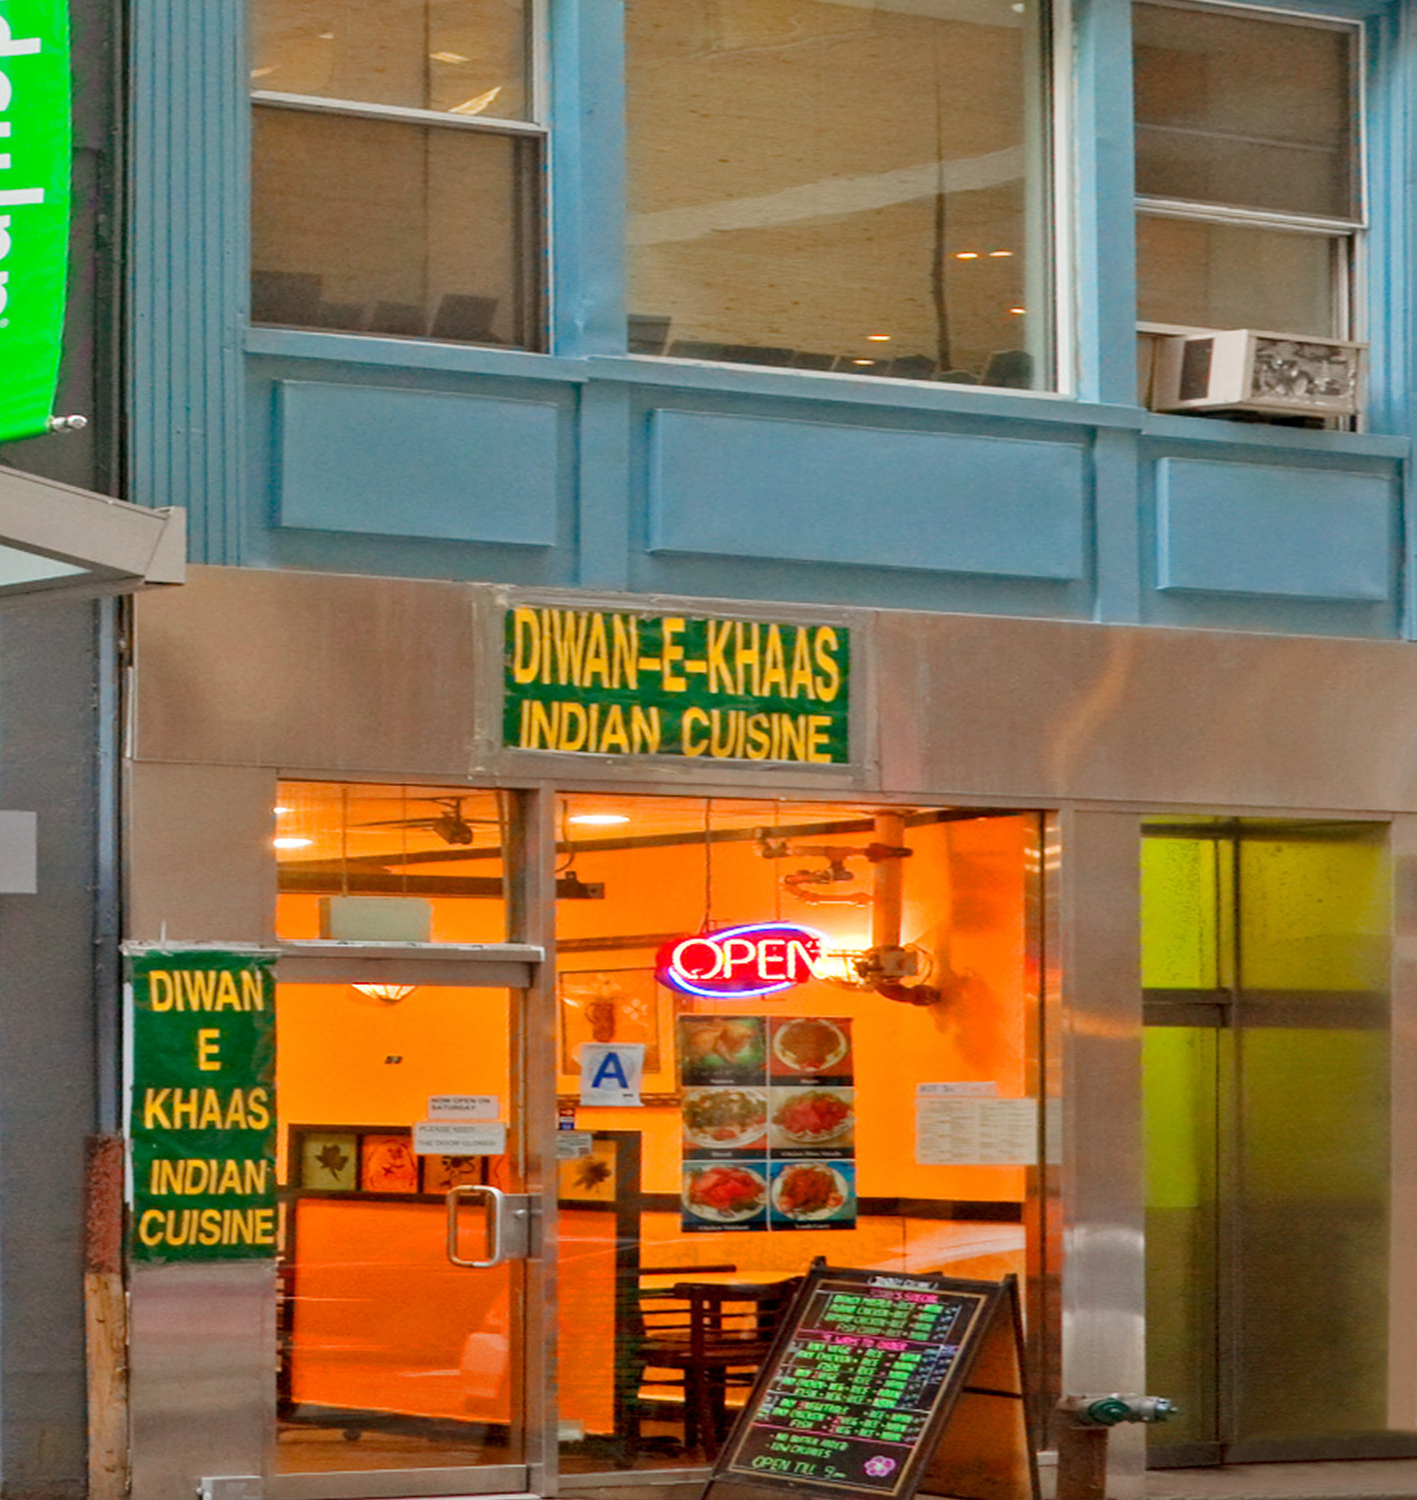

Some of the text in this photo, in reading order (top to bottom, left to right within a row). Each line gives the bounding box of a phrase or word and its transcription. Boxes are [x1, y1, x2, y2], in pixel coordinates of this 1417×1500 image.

[513, 606, 841, 703] DIWAN-E-KHAAS
[519, 699, 833, 764] INDIAN CUISINE
[672, 938, 829, 980] OPEN
[149, 969, 265, 1012] DIWAN
[198, 1028, 222, 1071] E
[591, 1052, 629, 1089] A
[143, 1086, 271, 1131] KHAAS
[150, 1159, 267, 1195] INDIAN
[138, 1208, 276, 1246] CUISINE
[751, 1455, 790, 1470] OPEN
[794, 1462, 817, 1474] TILL
